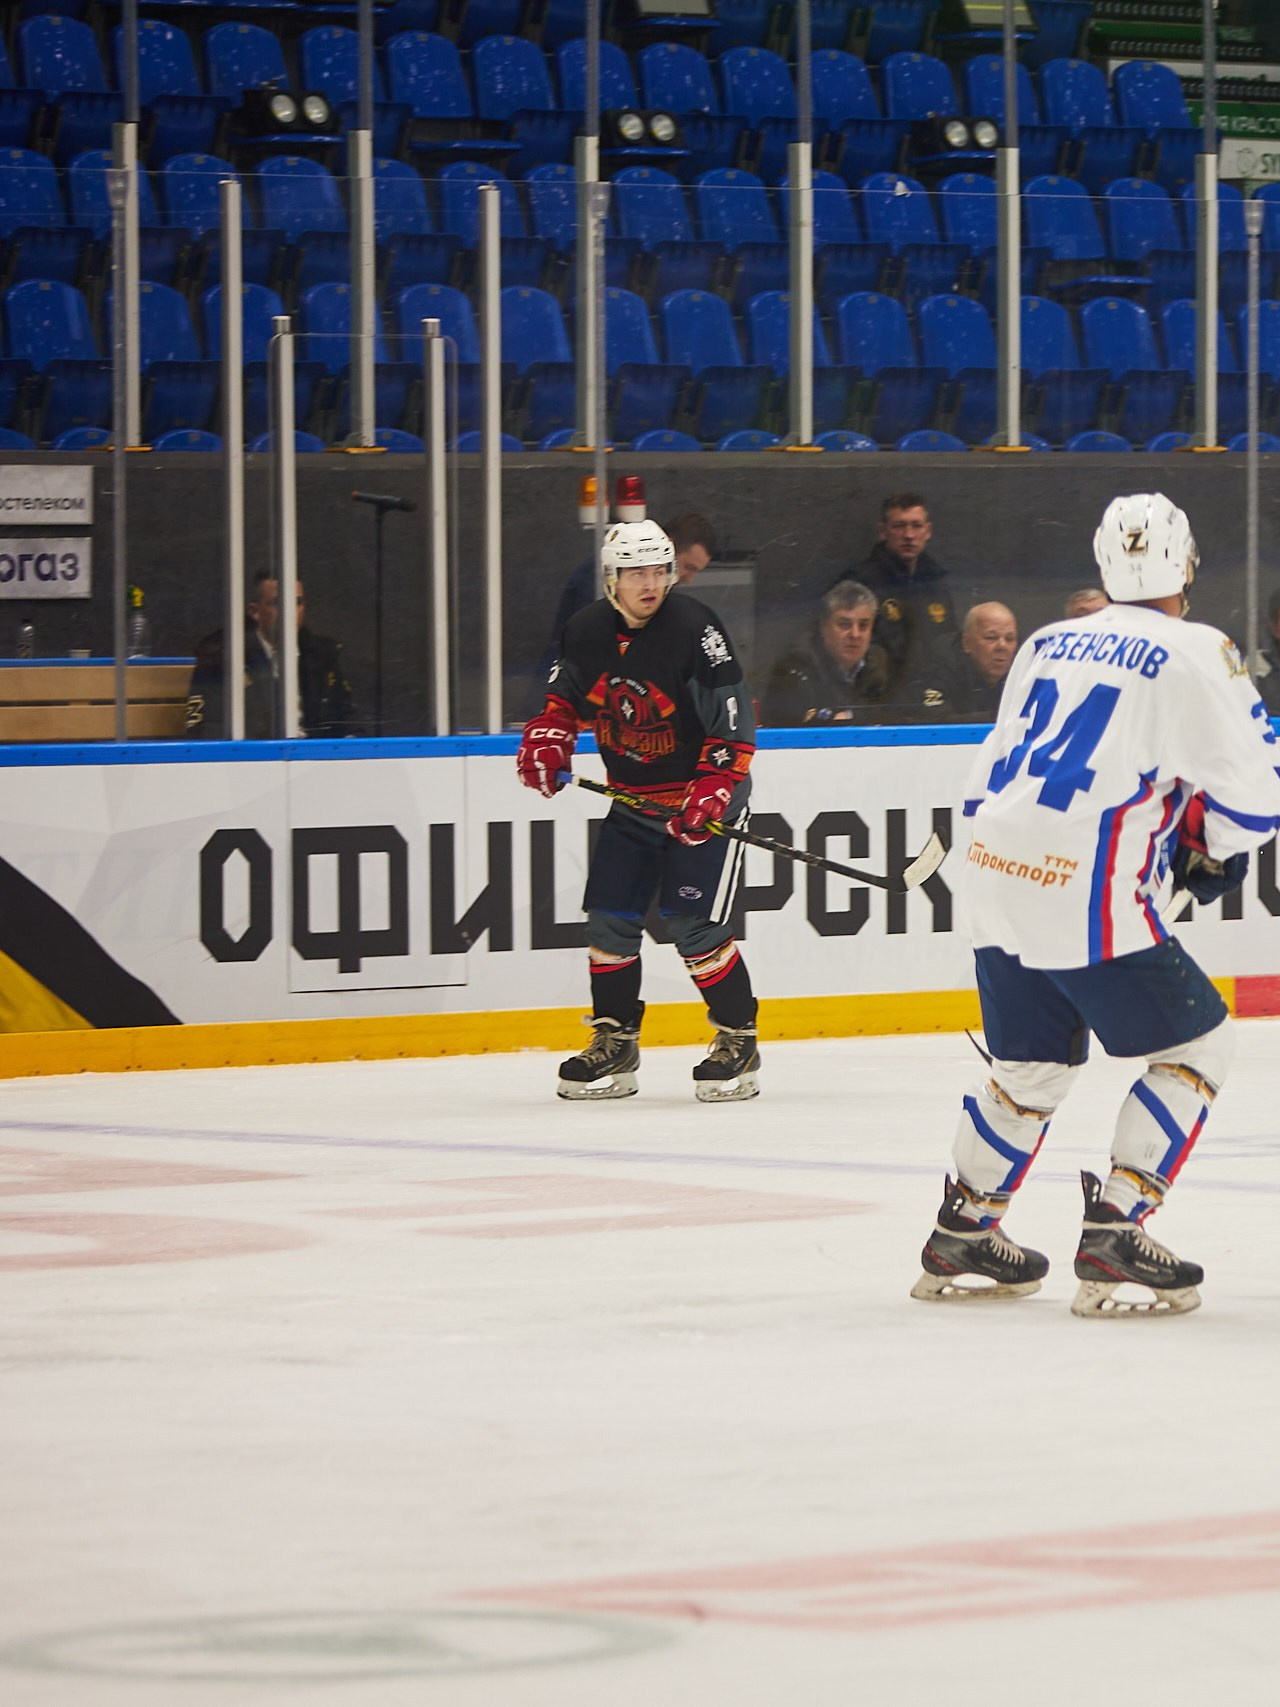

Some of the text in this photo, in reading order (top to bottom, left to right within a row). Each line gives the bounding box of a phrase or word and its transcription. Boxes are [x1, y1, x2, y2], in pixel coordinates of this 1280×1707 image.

[1034, 632, 1169, 679] БЕНСКОВ
[987, 678, 1121, 812] 34
[200, 807, 953, 974] ОФИРСК
[1045, 854, 1080, 870] ТТМ
